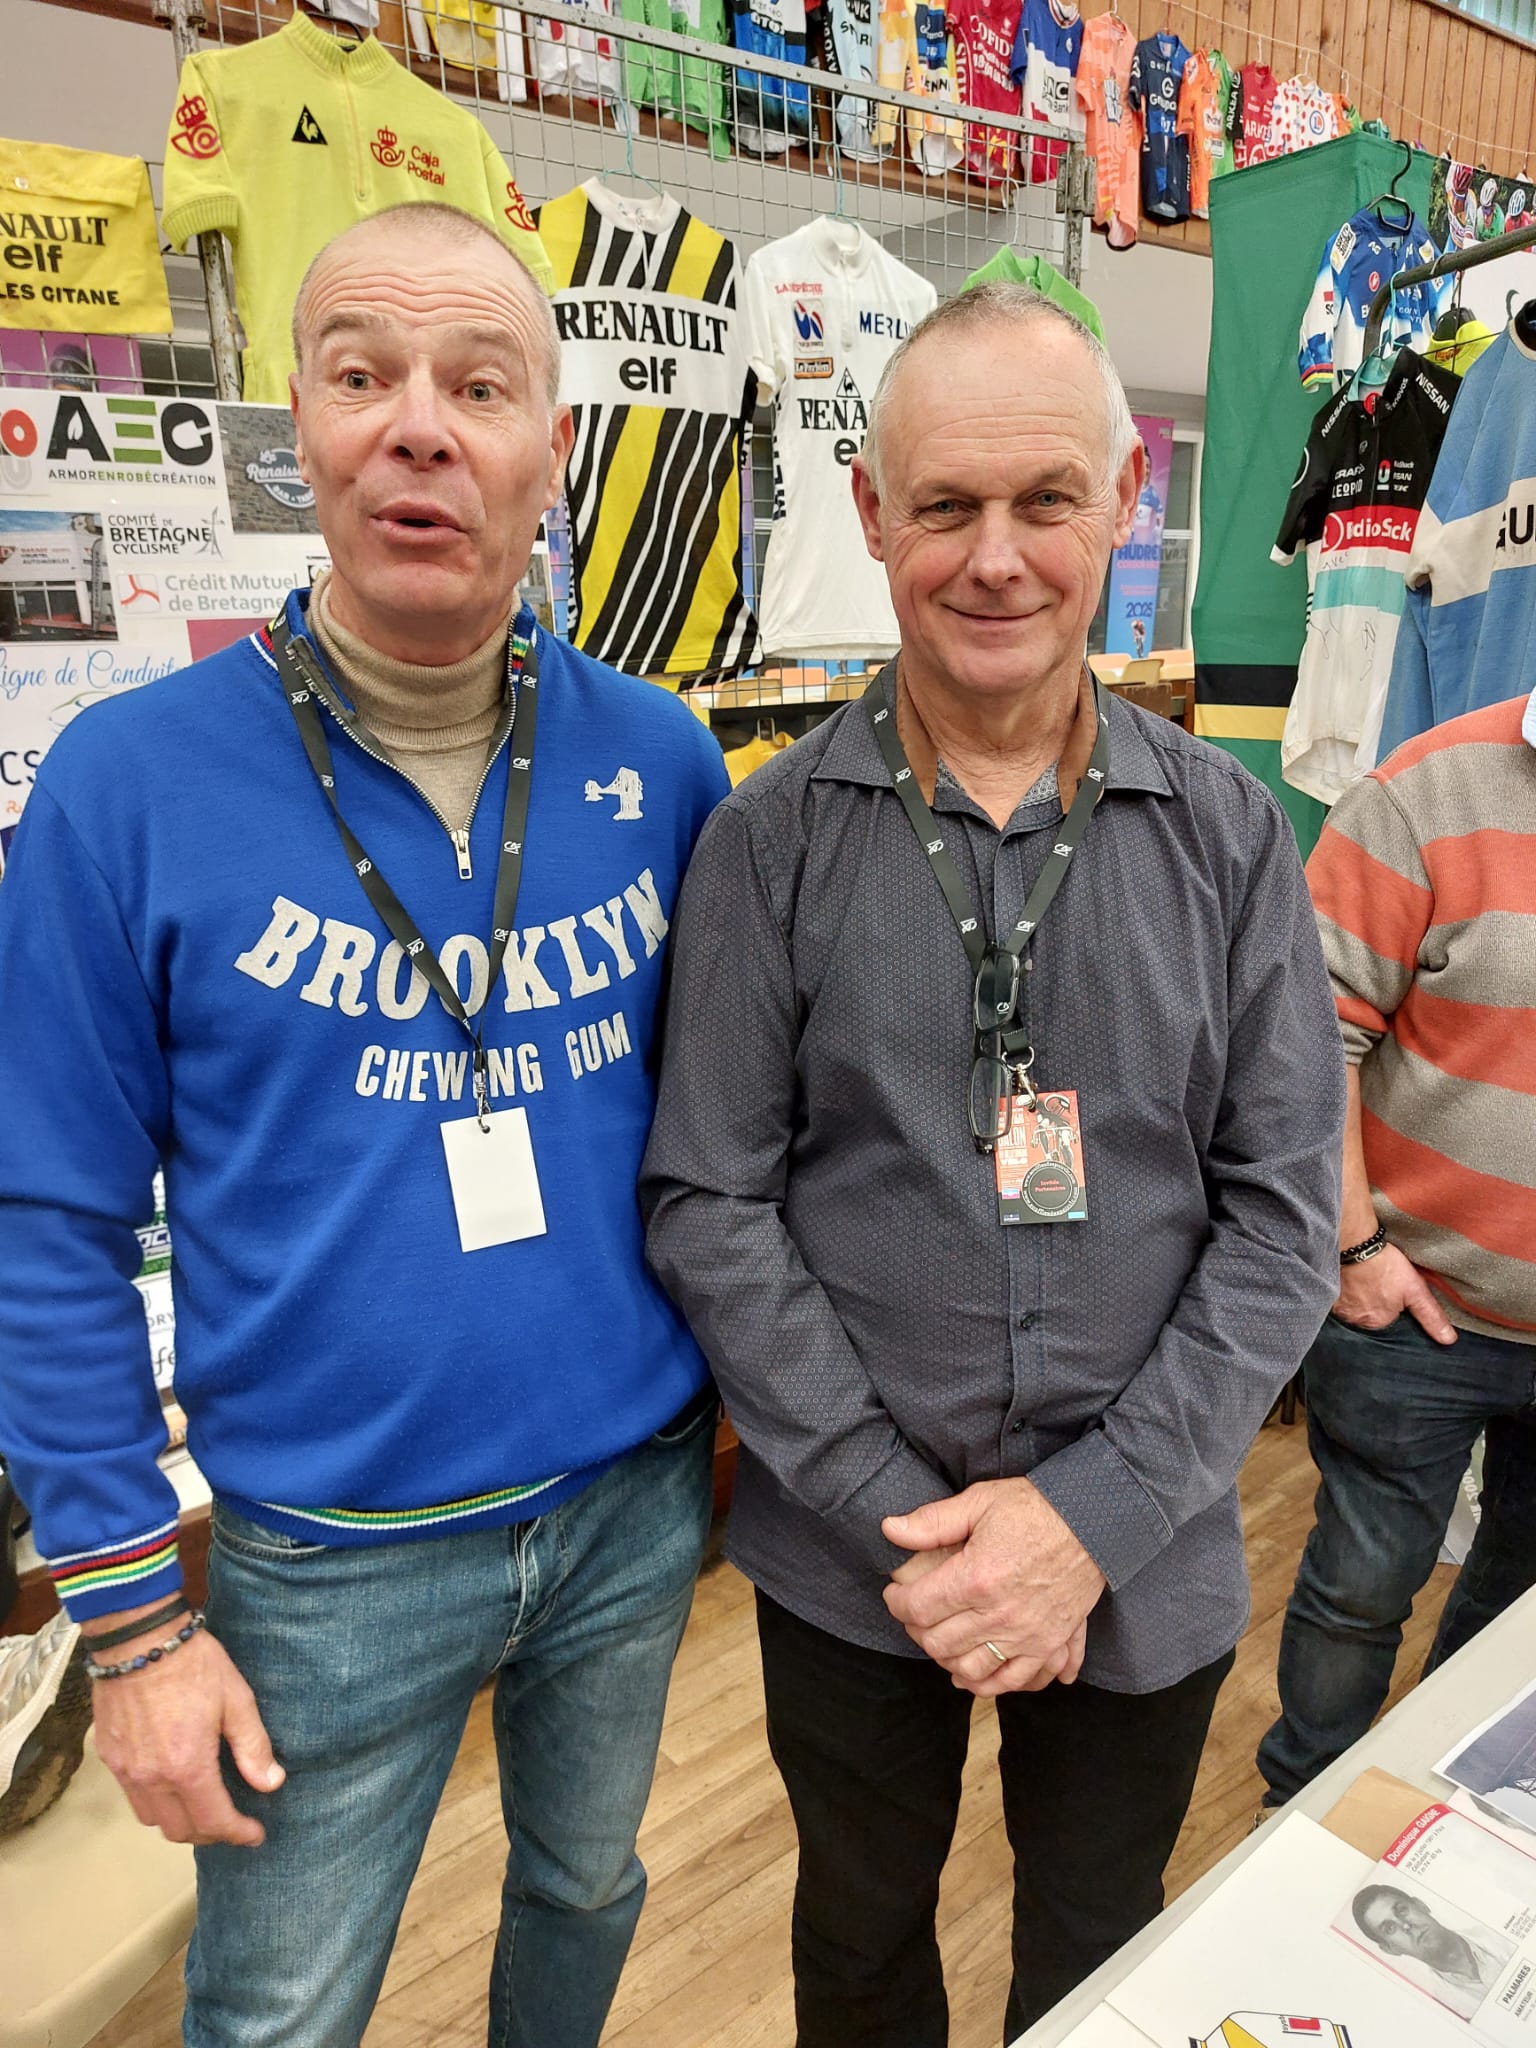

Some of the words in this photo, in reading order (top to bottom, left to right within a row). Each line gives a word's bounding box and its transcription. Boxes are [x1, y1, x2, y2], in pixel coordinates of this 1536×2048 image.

[1244, 119, 1270, 141] ARKE
[411, 144, 440, 168] Caja
[407, 162, 445, 187] Postal
[0, 213, 108, 246] NAULT
[4, 243, 63, 273] elf
[41, 286, 120, 306] GITANE
[553, 300, 728, 356] RENAULT
[619, 356, 677, 395] elf
[1415, 372, 1450, 415] NISSAN
[797, 398, 868, 431] RENA
[46, 395, 214, 467] AEC
[48, 468, 216, 486] ARMORENROBÉCRÉATION
[108, 513, 157, 527] COMITÉ
[163, 518, 174, 527] DE
[110, 526, 212, 548] BRETAGNE
[113, 543, 180, 556] CYCLISME
[165, 573, 226, 592] Crédit
[231, 573, 299, 591] Mutuel
[169, 594, 191, 612] de
[198, 595, 284, 615] Bretagne
[55, 657, 79, 686] de
[86, 649, 184, 690] Conduit
[233, 867, 670, 1021] BROOKLYN
[564, 1011, 633, 1080] GUM
[1386, 1826, 1420, 1862] Dominique
[1502, 1965, 1531, 2005] PALMARES
